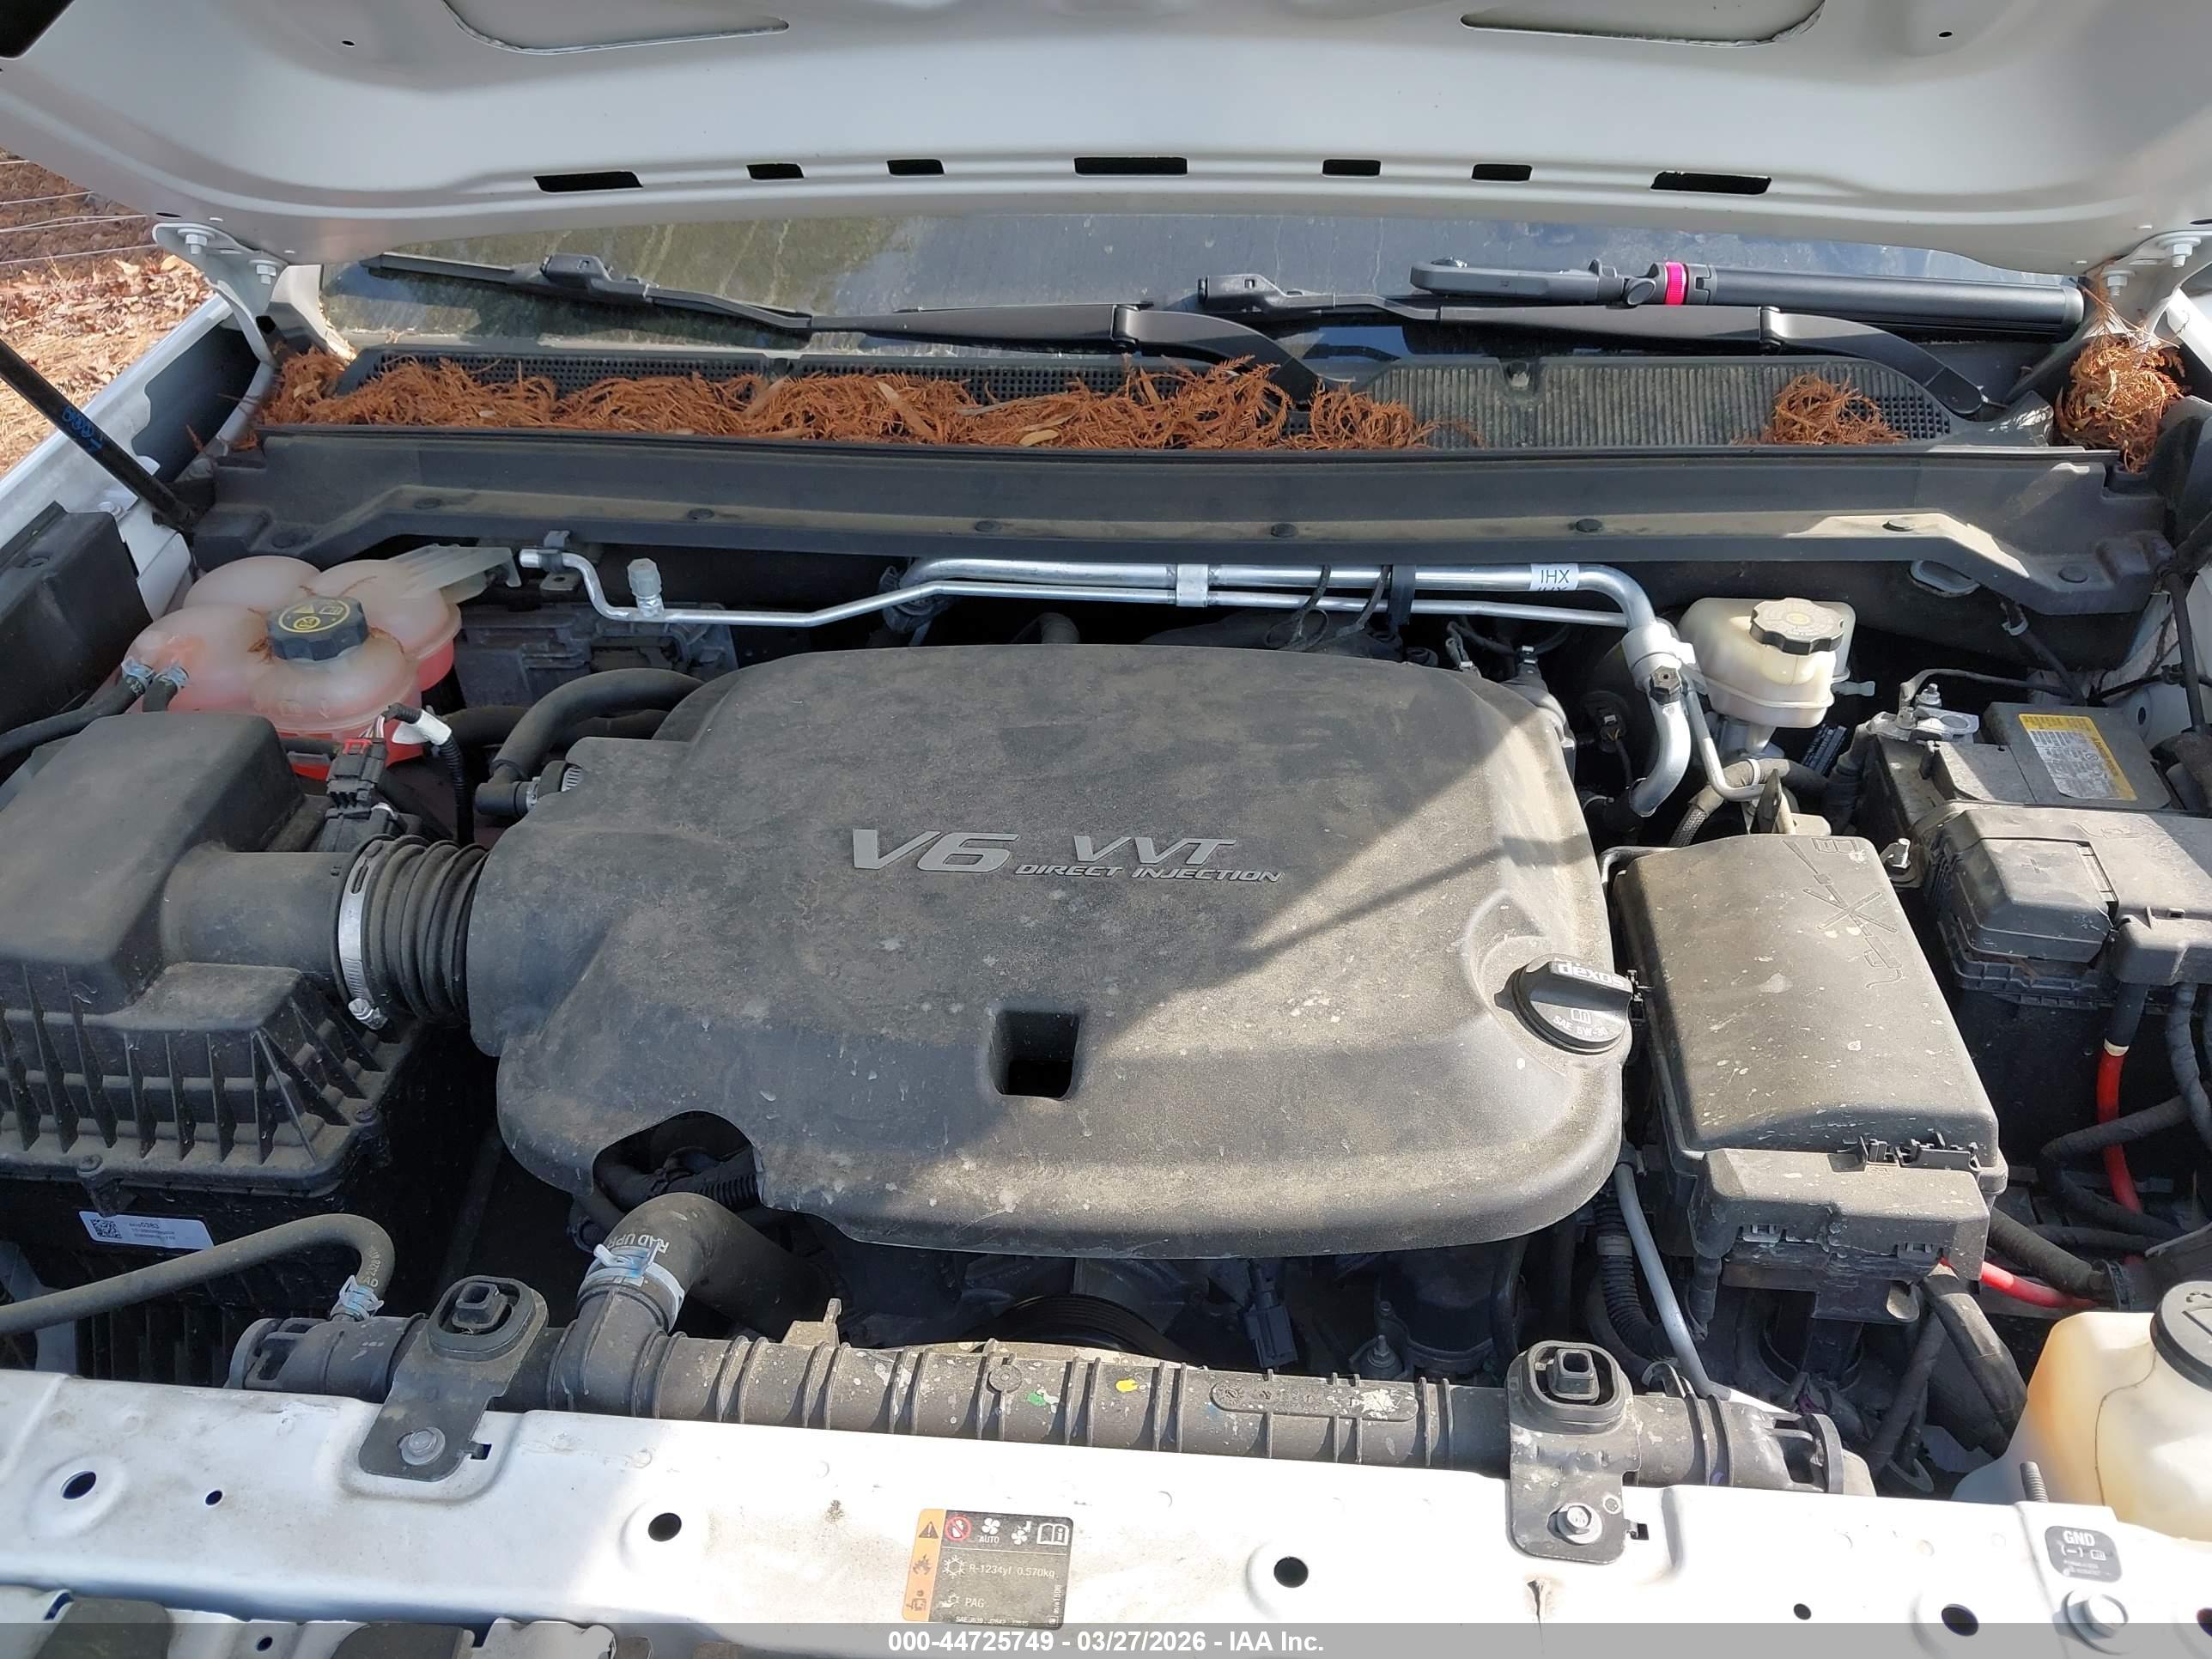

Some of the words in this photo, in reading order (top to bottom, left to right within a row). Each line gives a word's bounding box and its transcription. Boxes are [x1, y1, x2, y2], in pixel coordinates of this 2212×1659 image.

[1540, 569, 1571, 584] IHX
[853, 827, 1019, 873] V6
[1073, 835, 1237, 866] VVT
[1015, 862, 1124, 878] DIRECT
[1132, 866, 1285, 883] INJECTION
[1558, 961, 1626, 987] dexos
[1553, 1015, 1573, 1030] SAE
[1576, 1024, 1608, 1038] 5W-30
[979, 1535, 1000, 1544] AUTO
[2063, 1529, 2096, 1547] GND
[968, 1563, 1012, 1577] R-1234yf
[963, 1597, 985, 1607] PAG
